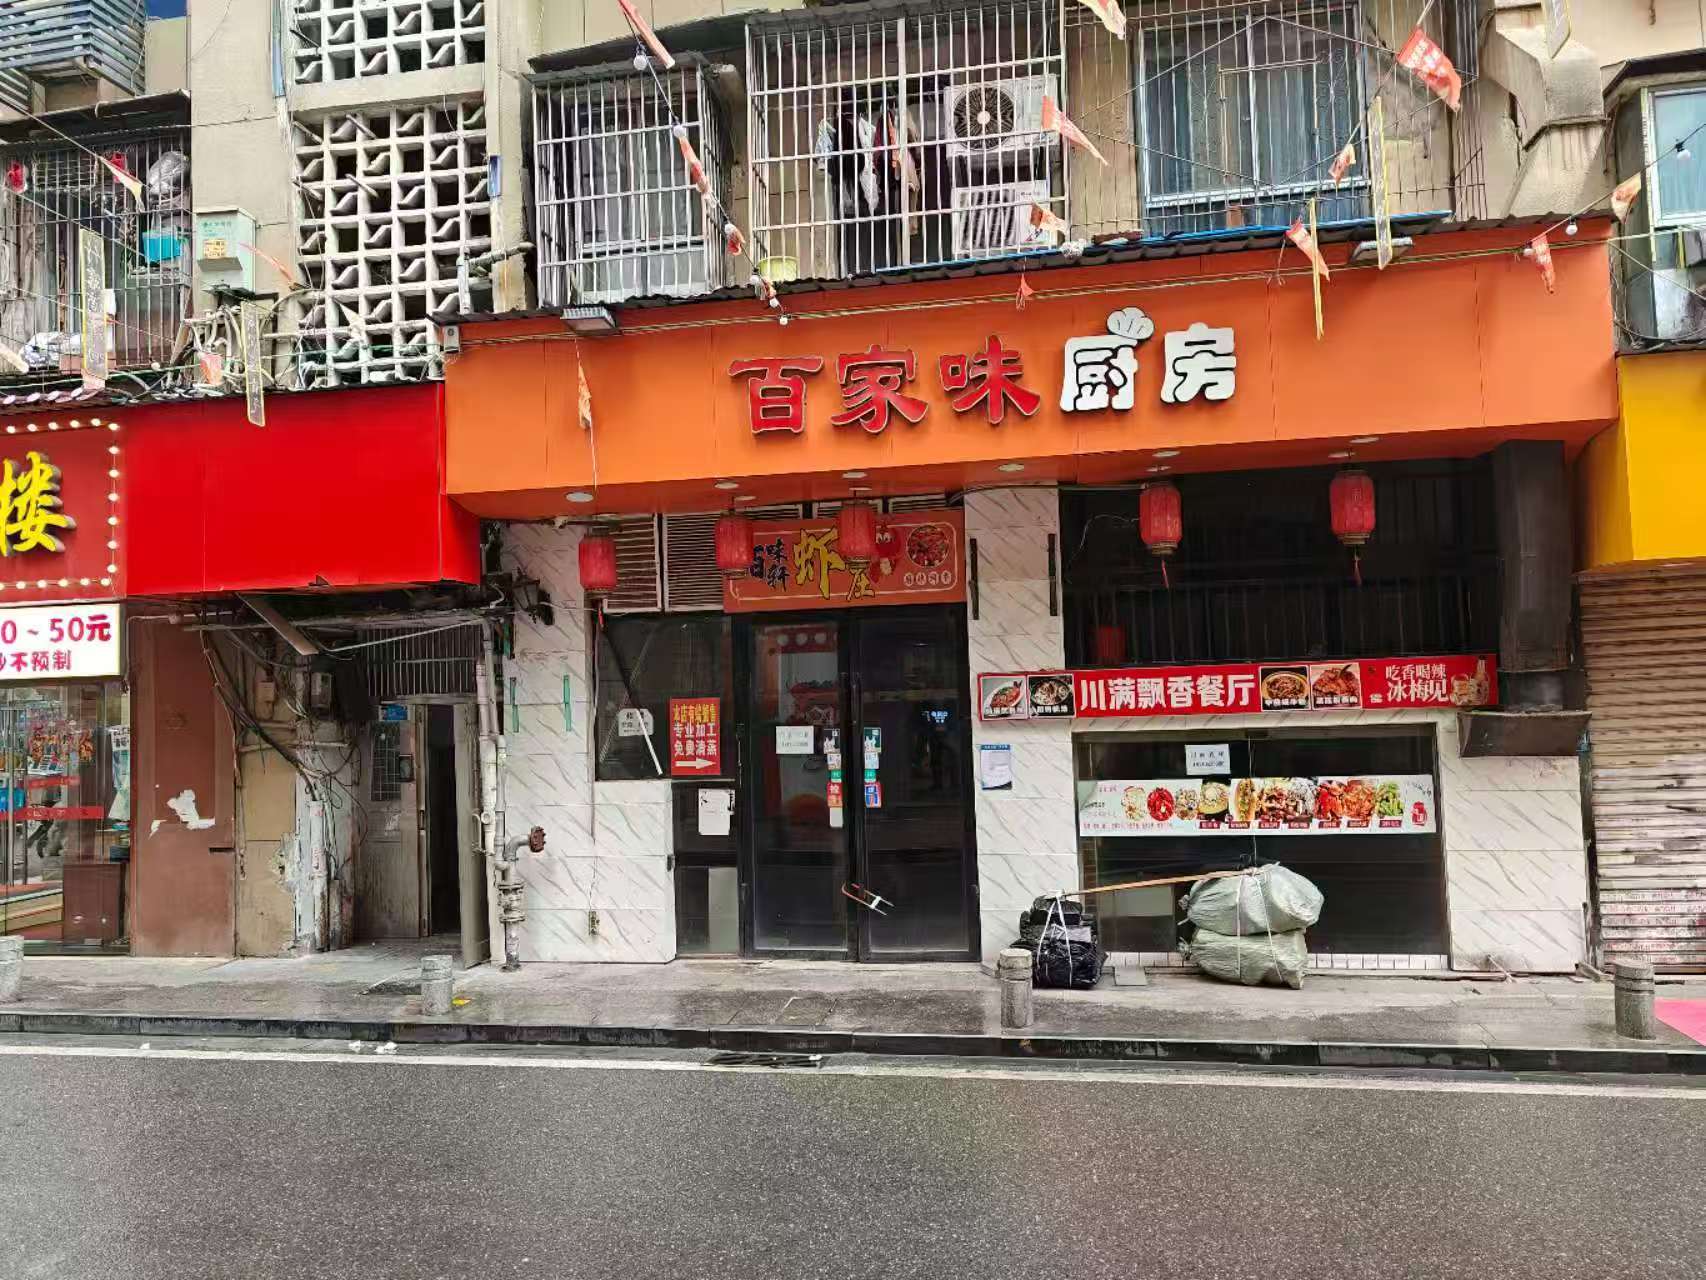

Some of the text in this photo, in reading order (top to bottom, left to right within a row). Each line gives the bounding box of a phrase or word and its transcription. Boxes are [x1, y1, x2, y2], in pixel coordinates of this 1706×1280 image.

[728, 322, 1236, 434] 百家味厨房
[0, 451, 69, 556] 楼
[1079, 673, 1256, 711] 川满飘香餐厅
